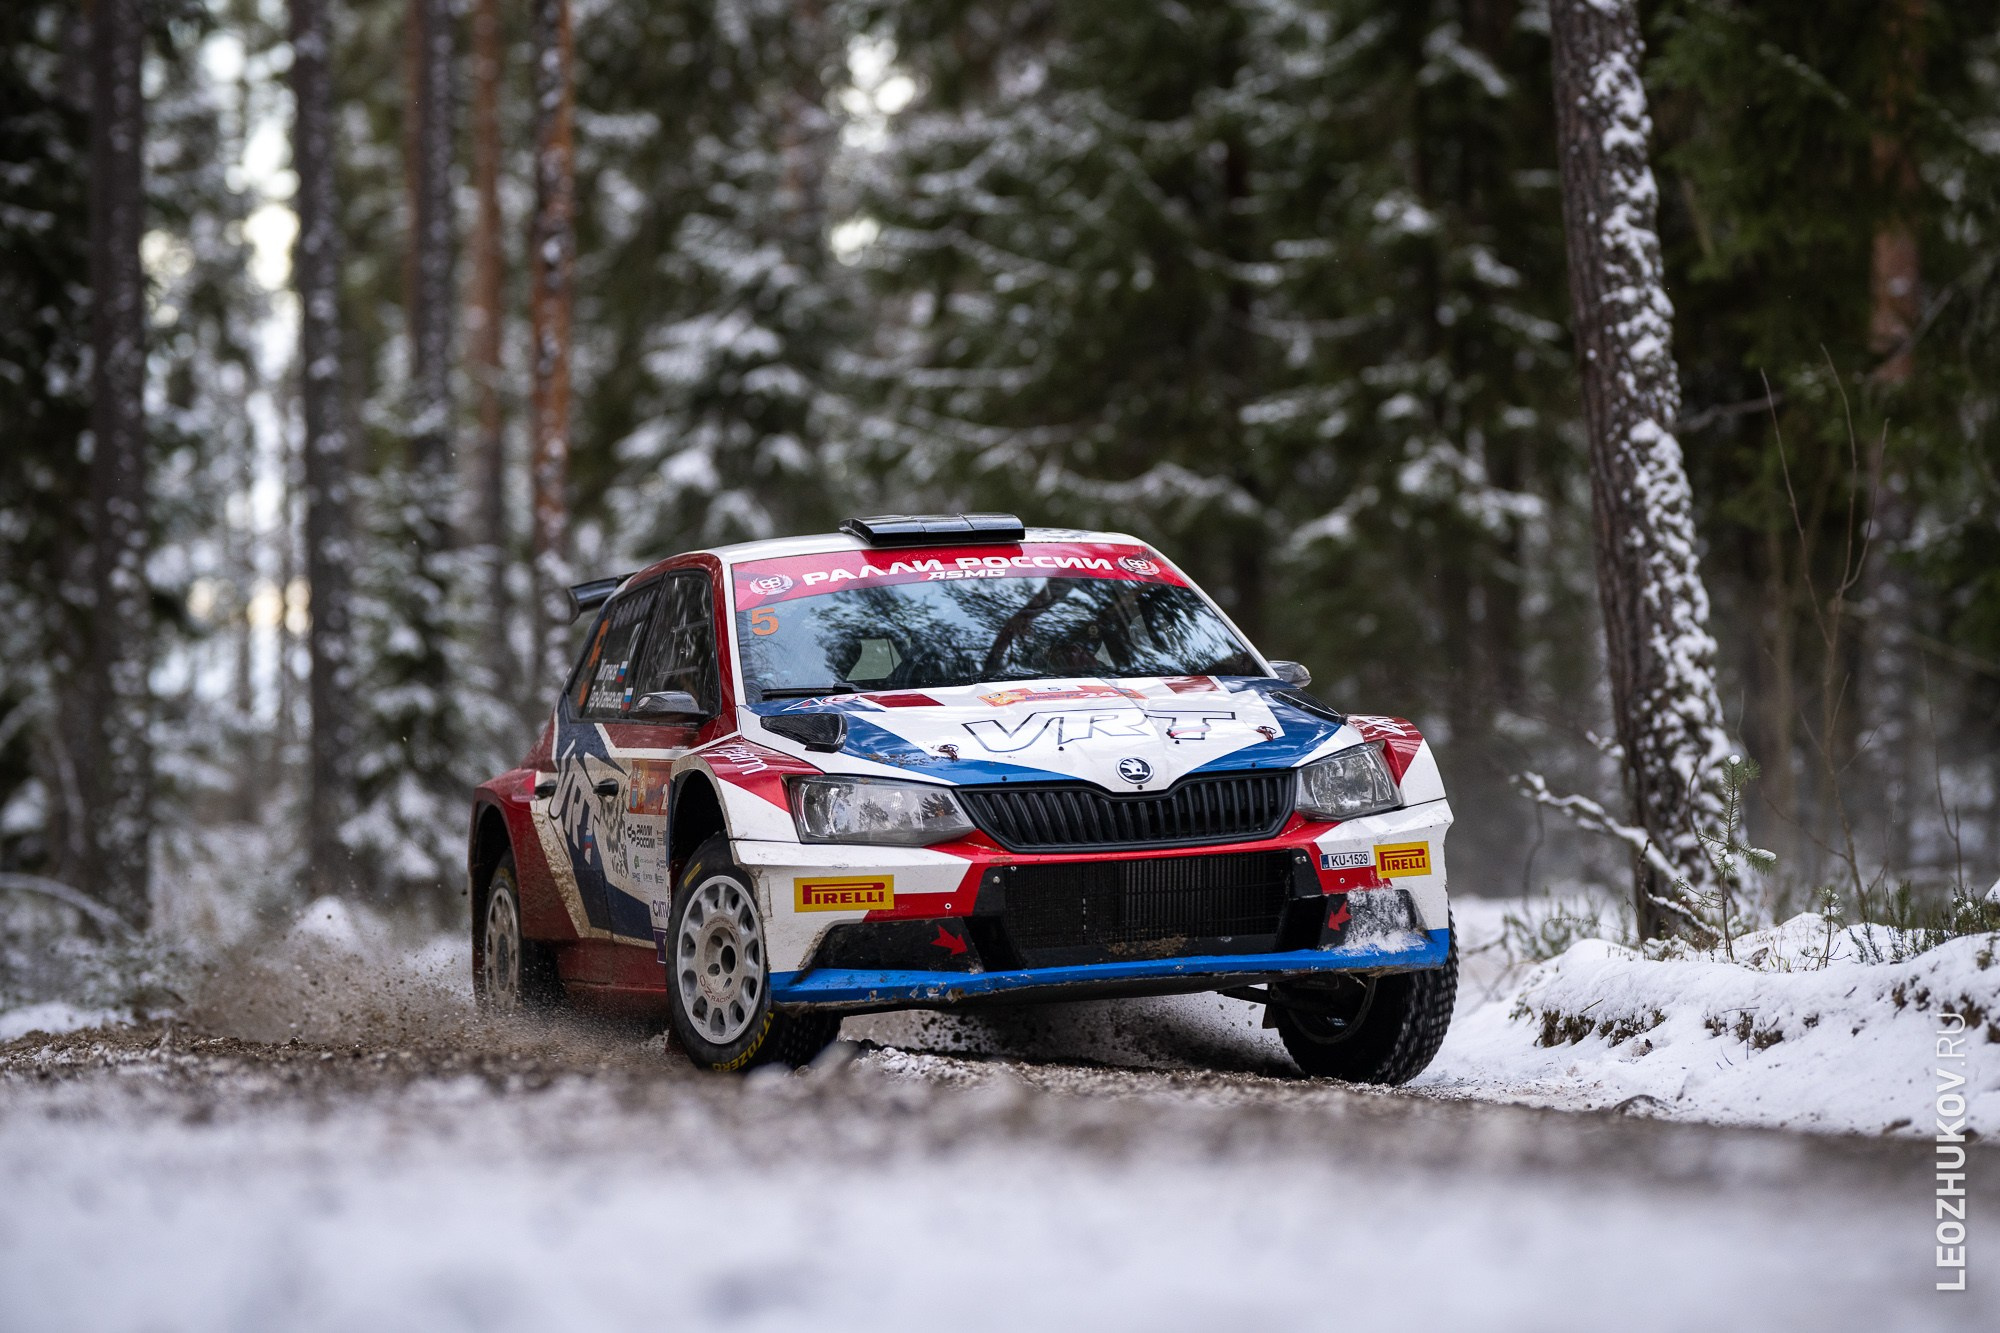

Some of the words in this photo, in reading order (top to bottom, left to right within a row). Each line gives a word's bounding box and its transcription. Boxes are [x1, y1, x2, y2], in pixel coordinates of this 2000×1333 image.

[801, 559, 945, 586] РАЛЛИ
[955, 556, 1113, 570] РОССИИ
[751, 607, 779, 636] 5
[961, 707, 1236, 752] VRT
[1331, 854, 1368, 866] KU-1529
[1379, 848, 1426, 871] PIRELLI
[802, 882, 885, 904] PIRELLI
